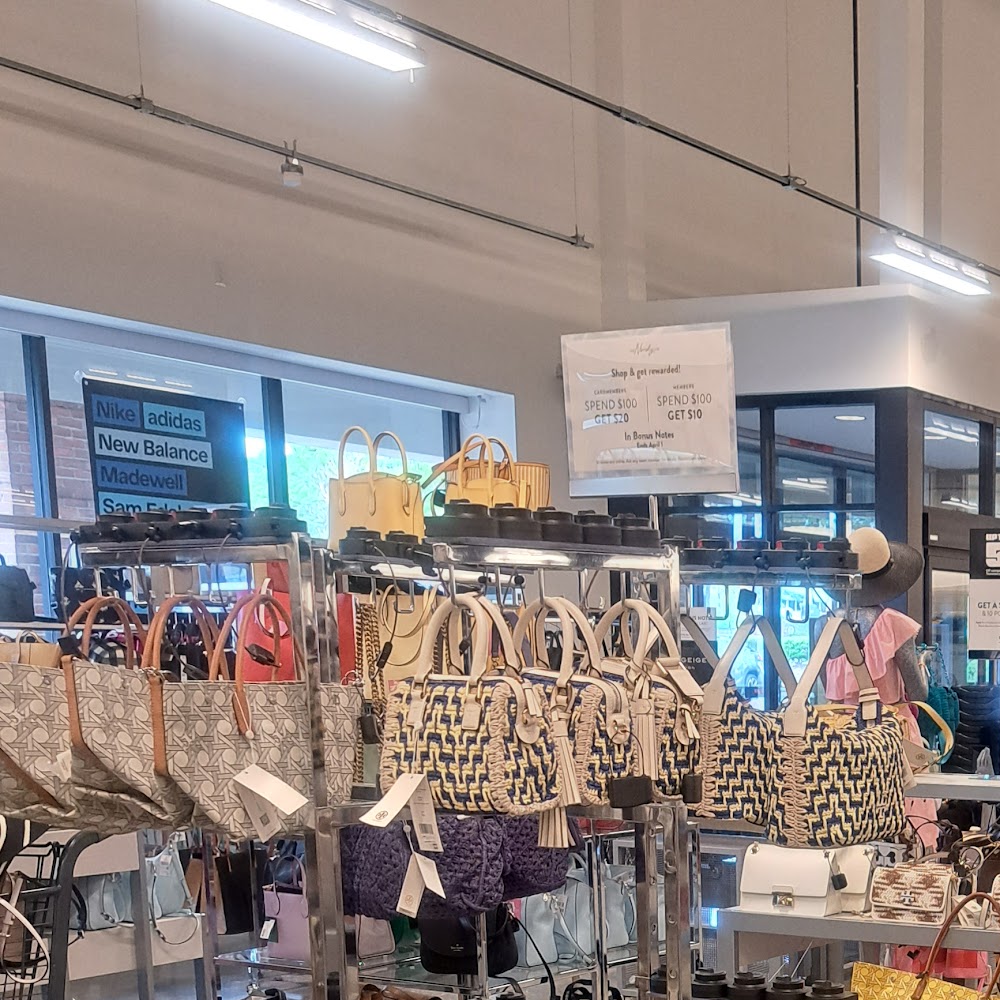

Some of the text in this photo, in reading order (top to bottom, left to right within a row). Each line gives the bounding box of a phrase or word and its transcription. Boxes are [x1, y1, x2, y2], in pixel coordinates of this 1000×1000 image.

[611, 364, 680, 380] Shop & get rewarded!
[584, 398, 638, 412] SPEND $100
[656, 393, 712, 407] SPEND $100
[96, 401, 202, 432] Nike adidas
[594, 412, 629, 424] GET $20
[668, 408, 702, 420] GET $10
[624, 430, 674, 440] In Bonus Notes
[98, 434, 208, 464] New Balance
[101, 466, 184, 490] Madewell
[103, 498, 142, 514] Sam
